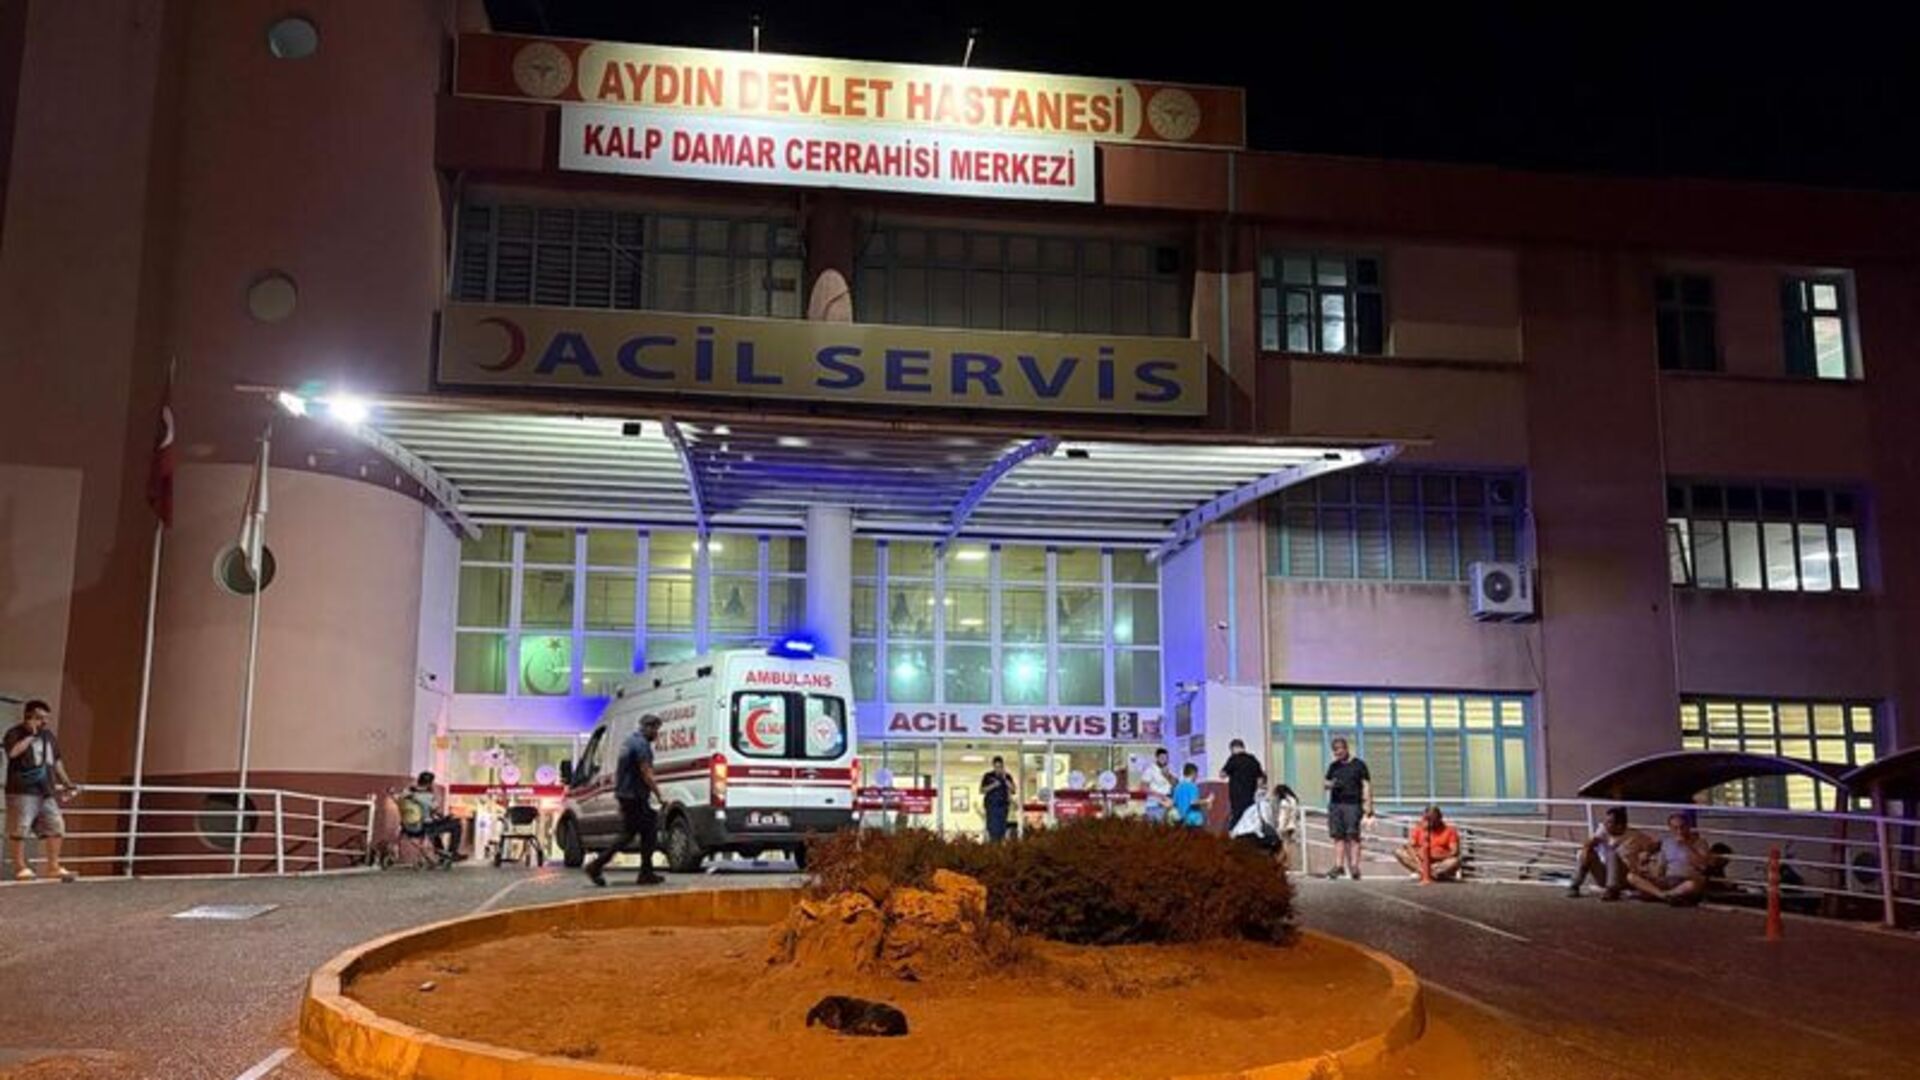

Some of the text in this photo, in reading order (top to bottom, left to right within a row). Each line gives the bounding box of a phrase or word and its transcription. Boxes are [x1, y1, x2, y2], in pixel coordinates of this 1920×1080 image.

[597, 61, 1124, 135] AYDIN DEVLET HASTANESİ
[584, 124, 1075, 187] KALP DAMAR CERRAHİSİ MERKEZİ
[745, 670, 833, 689] AMBULANS
